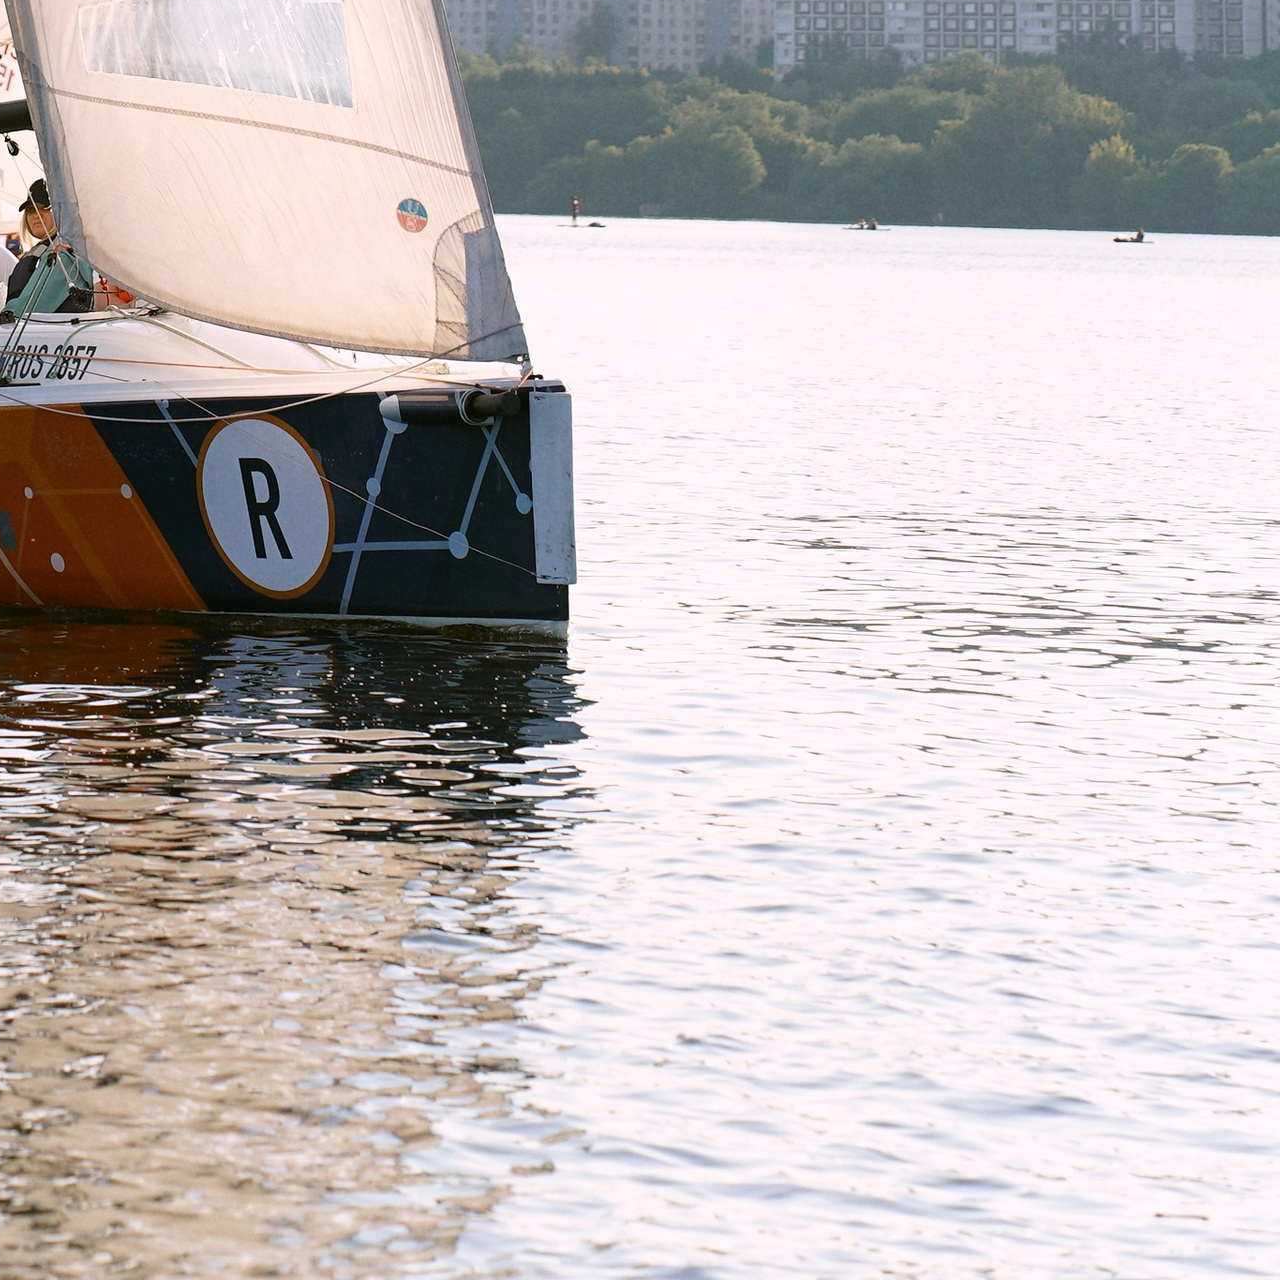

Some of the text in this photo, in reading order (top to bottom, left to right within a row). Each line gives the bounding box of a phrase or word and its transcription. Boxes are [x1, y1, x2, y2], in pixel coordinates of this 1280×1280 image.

[10, 344, 97, 381] RUS 2857
[238, 457, 293, 559] R
